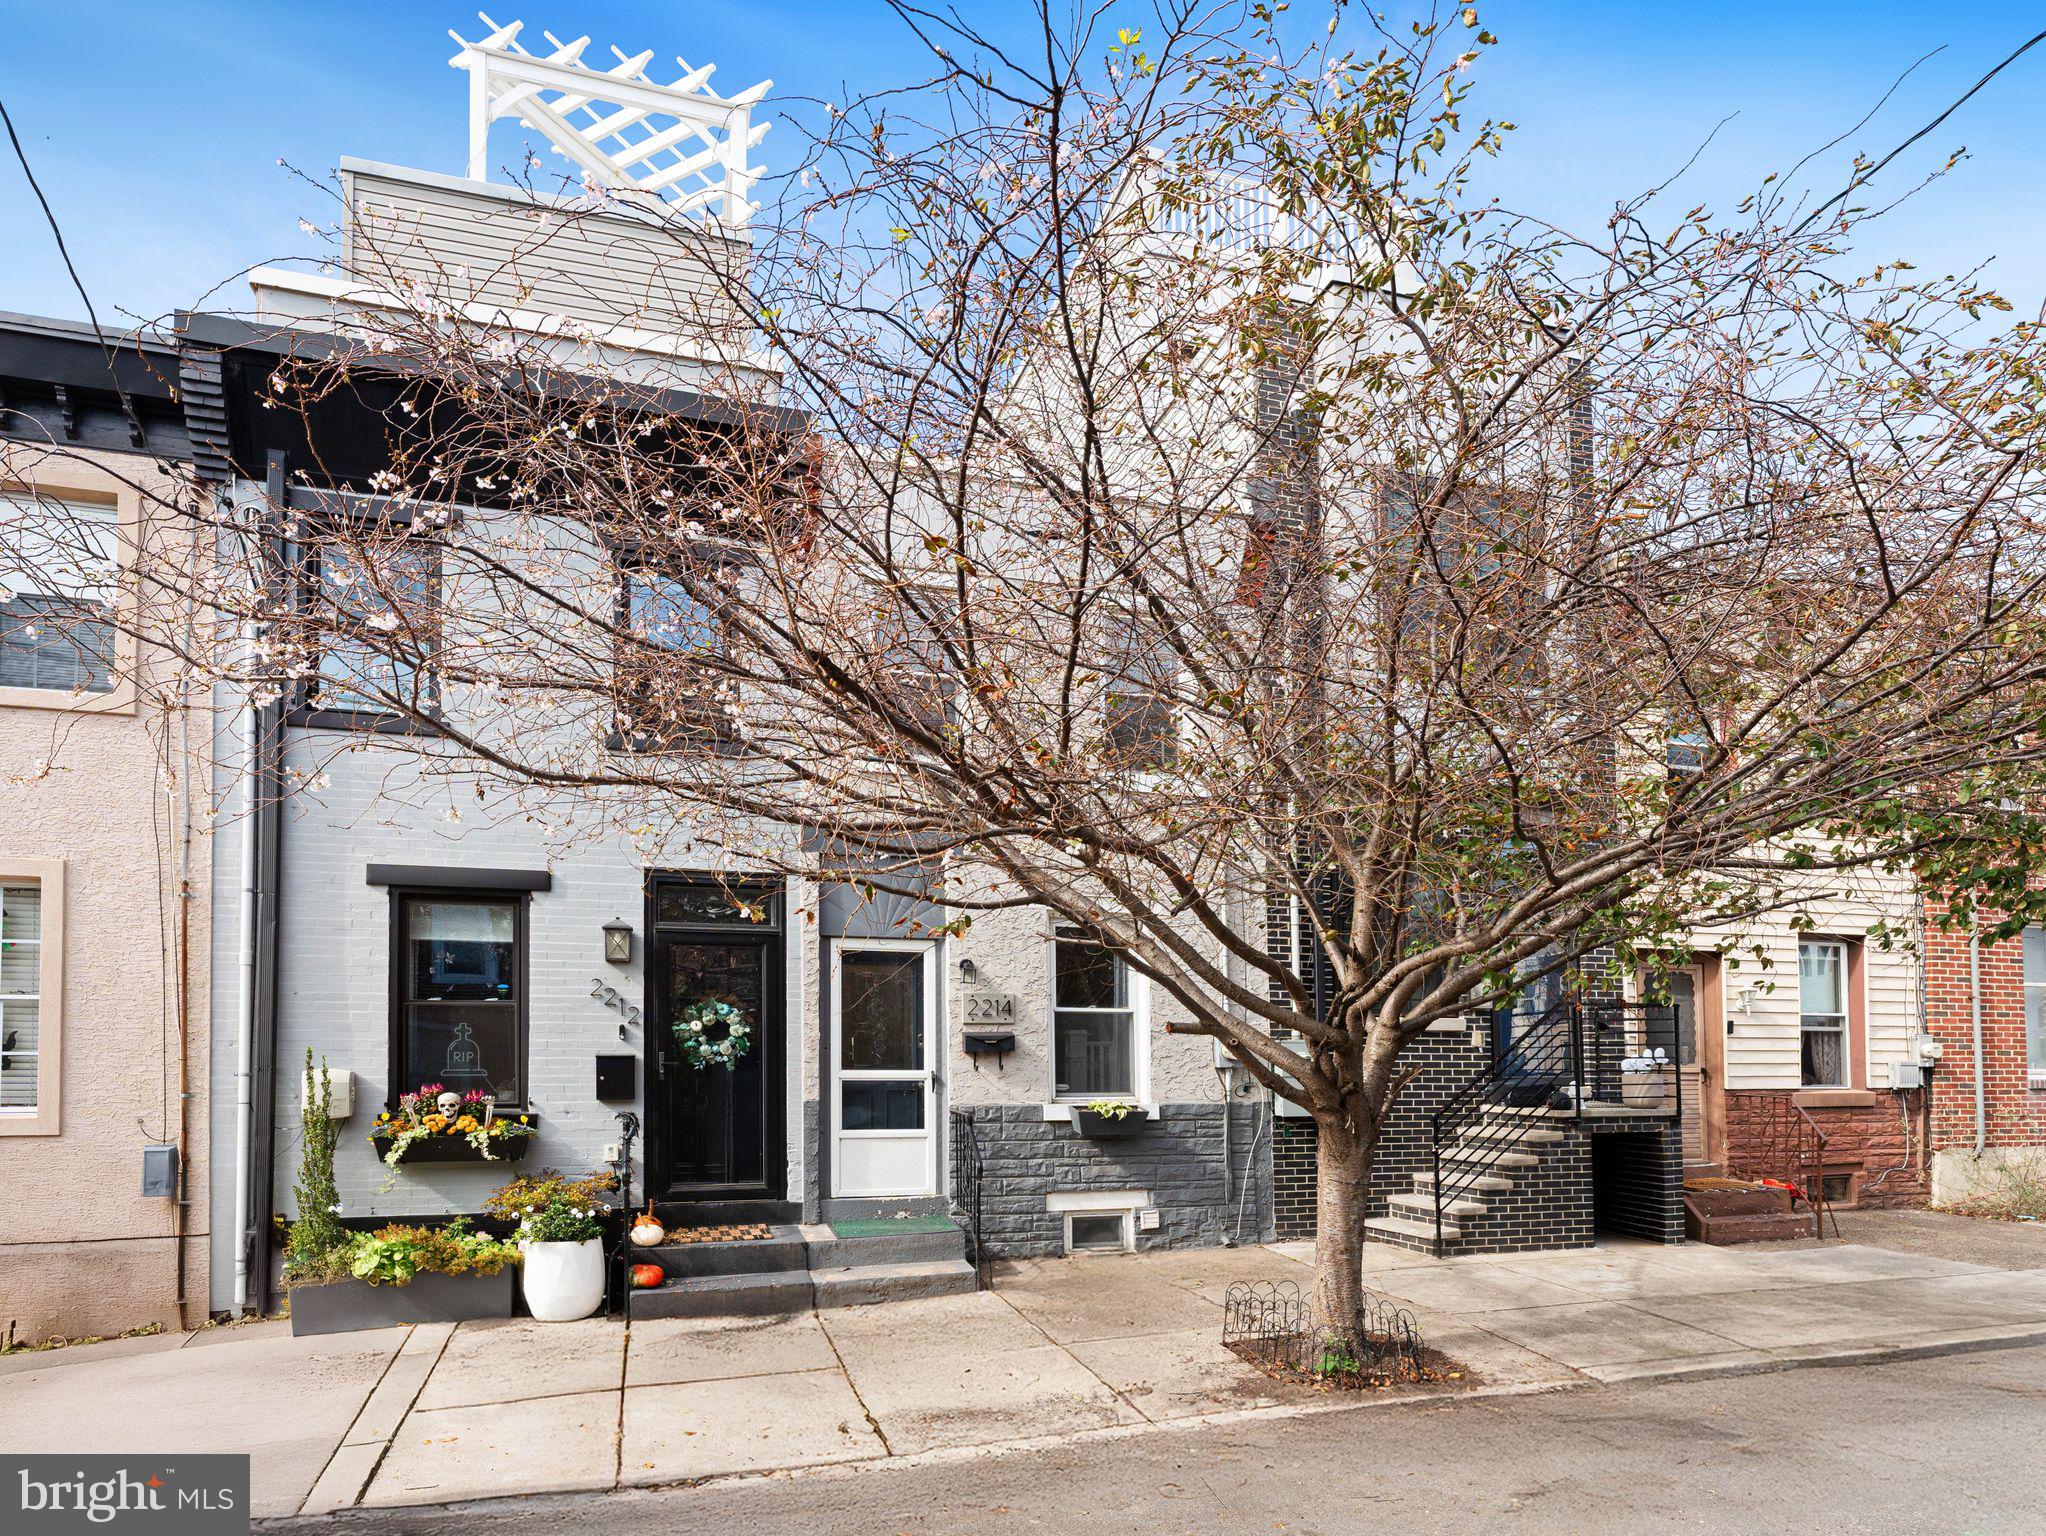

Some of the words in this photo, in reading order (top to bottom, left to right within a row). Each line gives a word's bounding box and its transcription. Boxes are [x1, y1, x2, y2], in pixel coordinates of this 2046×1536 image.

[590, 977, 640, 1025] 2212
[967, 998, 1013, 1017] 2214
[453, 1051, 474, 1062] RIP
